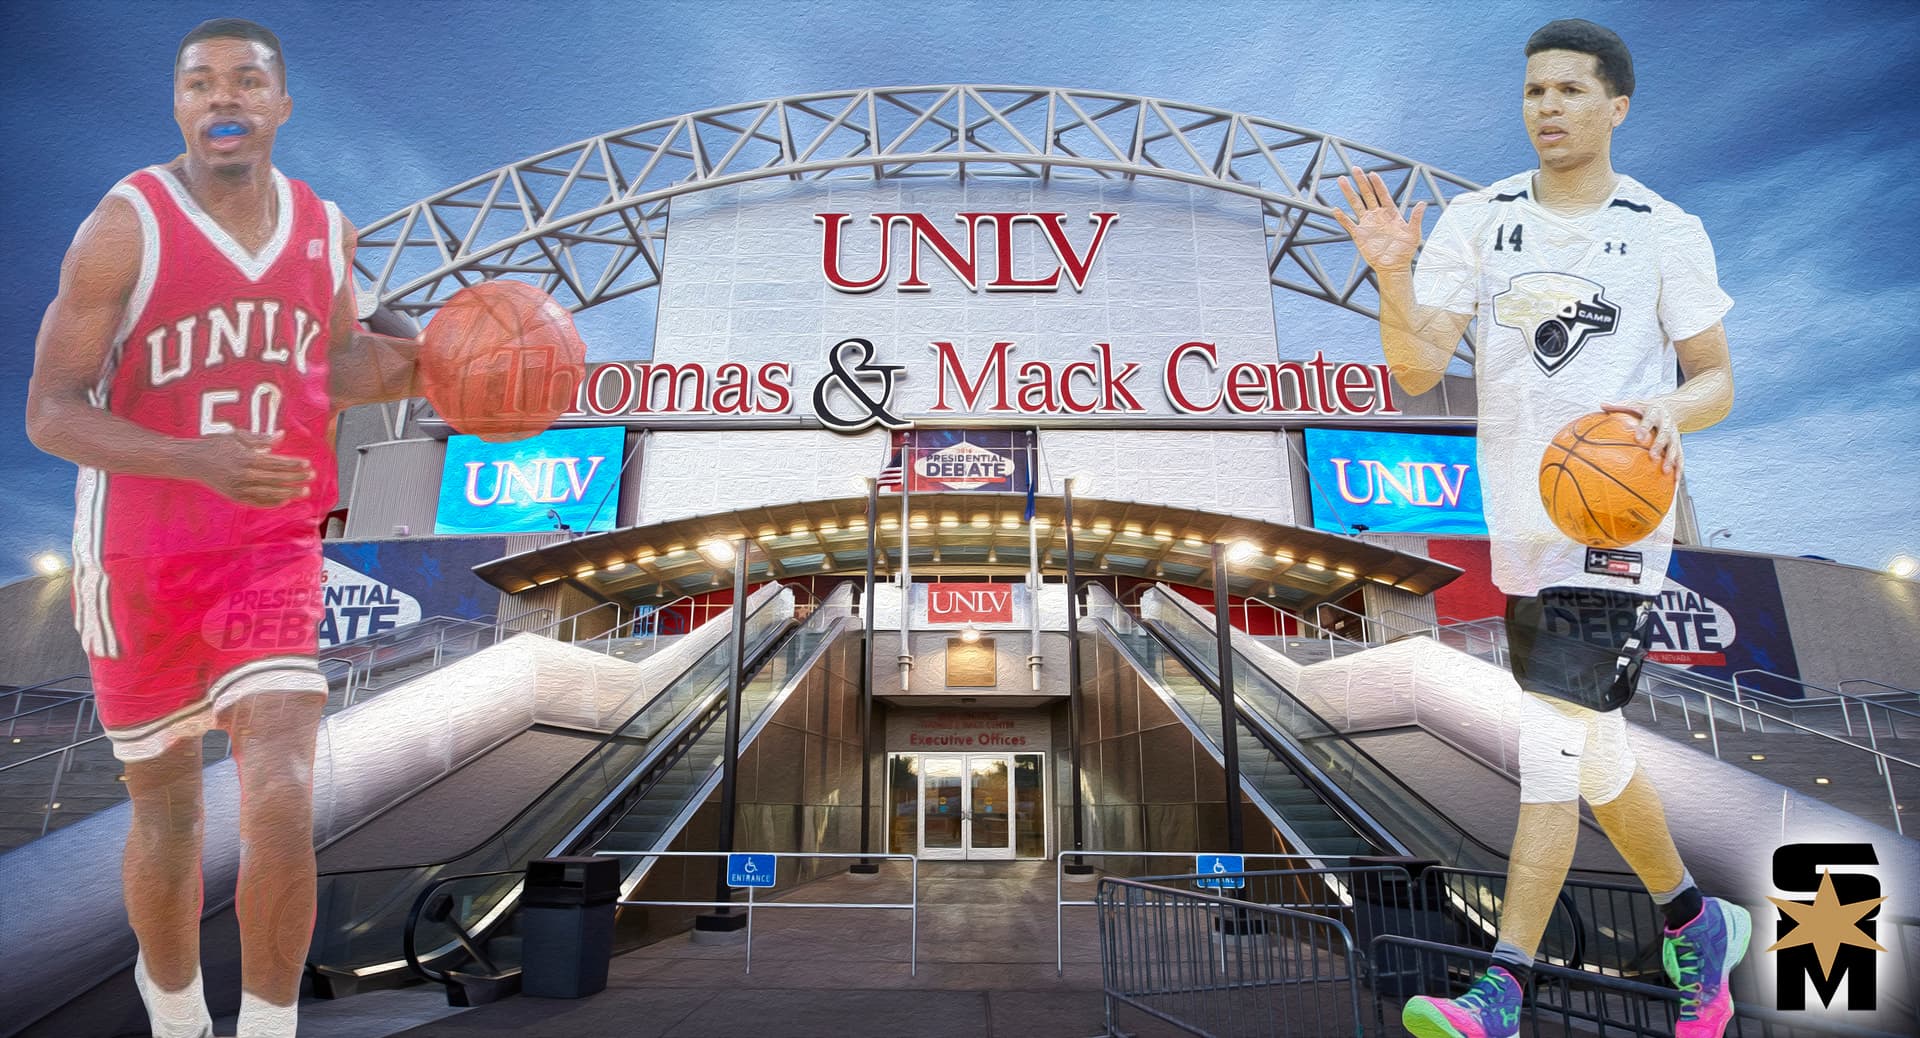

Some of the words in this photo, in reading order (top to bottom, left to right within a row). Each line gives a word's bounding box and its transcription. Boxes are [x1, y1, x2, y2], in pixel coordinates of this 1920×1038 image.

[813, 211, 1119, 292] UNLV
[1494, 224, 1523, 252] 14
[1578, 309, 1613, 324] CAMP
[147, 301, 320, 385] UNLV
[492, 343, 794, 418] Thomas
[812, 338, 915, 432] &
[929, 341, 1147, 414] Mack
[1163, 341, 1403, 416] Center
[926, 454, 1005, 463] PRESIDENTIAL
[926, 462, 1006, 477] DEBATE
[464, 456, 605, 507] UNLV
[1330, 458, 1471, 508] UNLV
[228, 584, 400, 610] PRESIDENTIAL
[930, 590, 1010, 614] UNLV
[221, 605, 400, 650] DEBATE
[910, 732, 973, 746] Executive
[978, 732, 1026, 746] Offices
[731, 873, 771, 883] ENTRANCE
